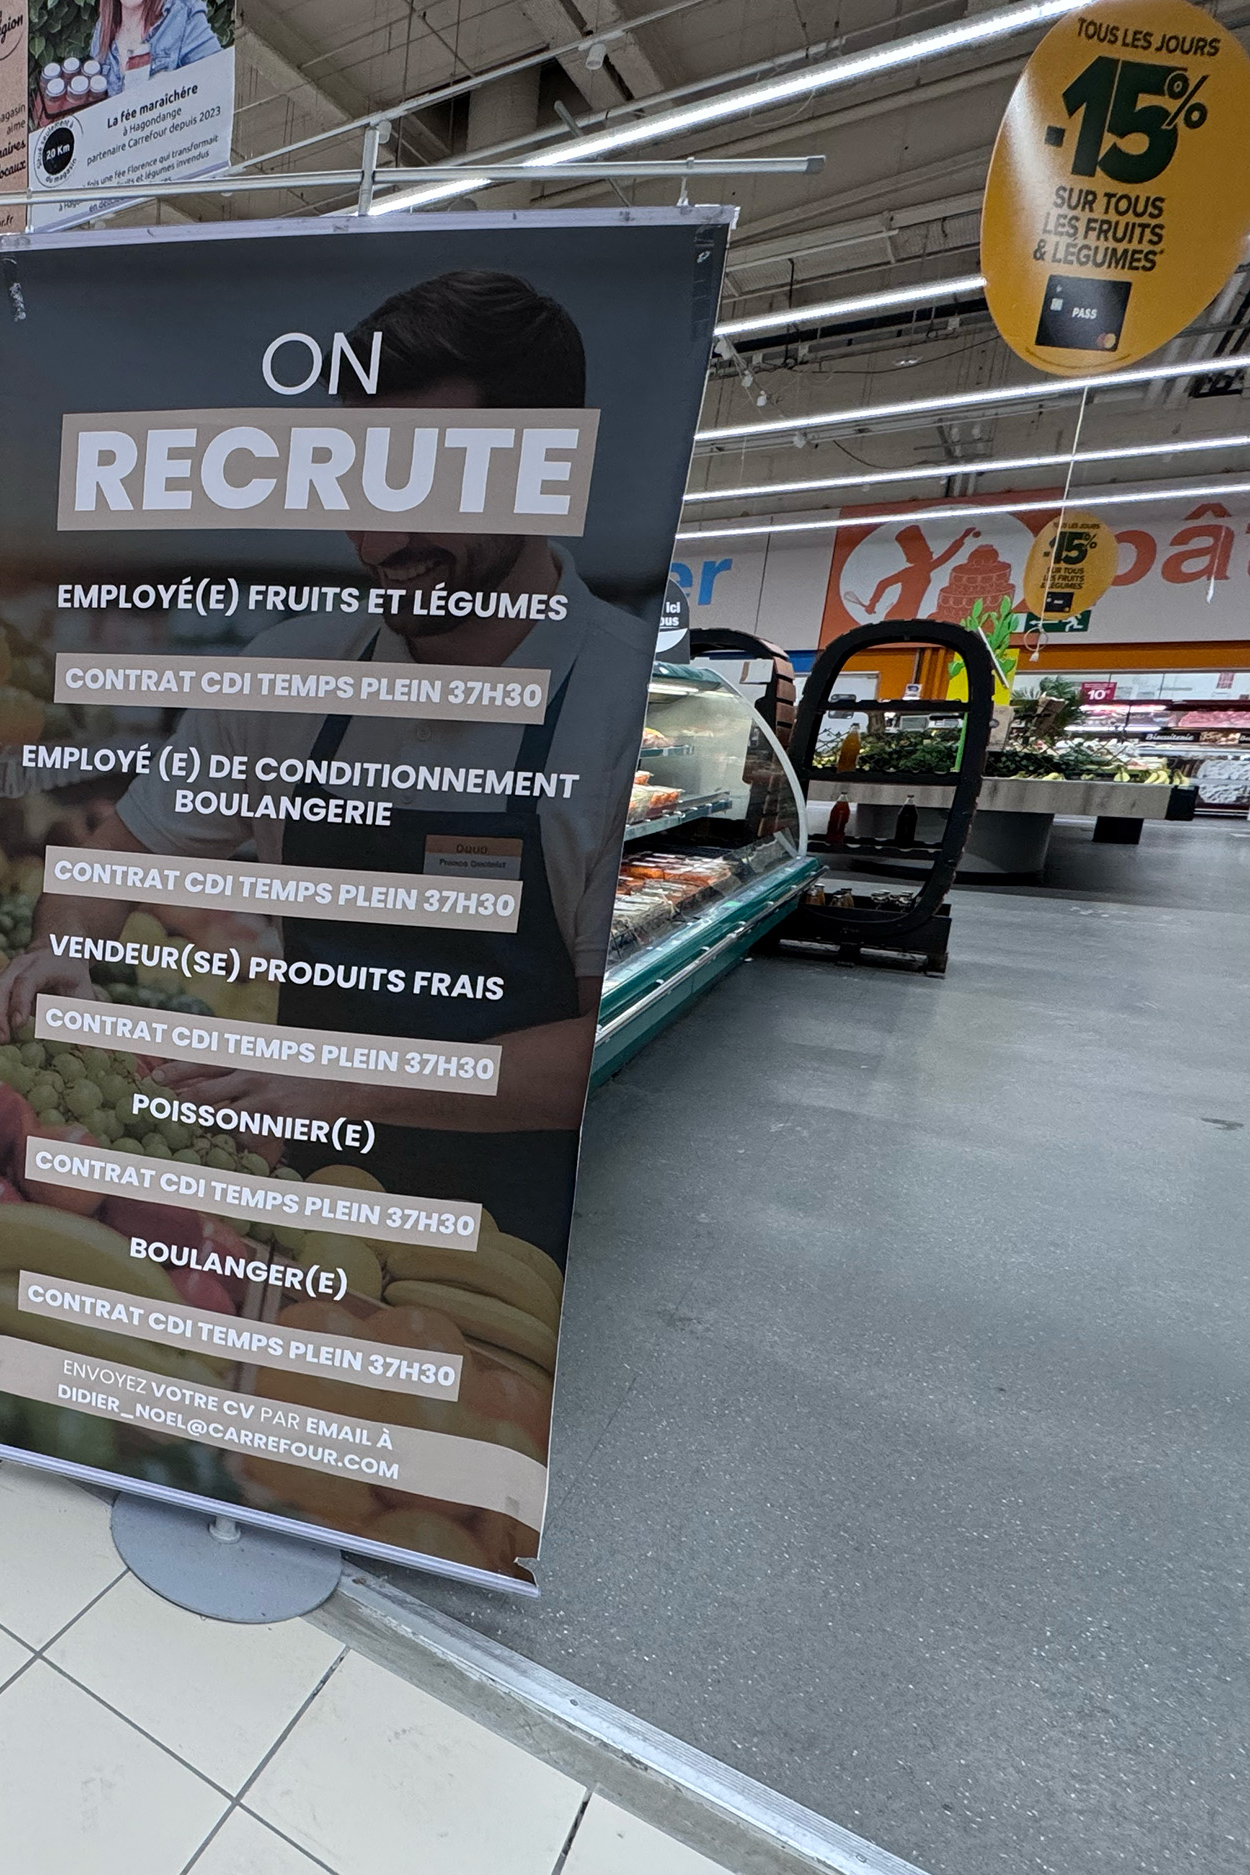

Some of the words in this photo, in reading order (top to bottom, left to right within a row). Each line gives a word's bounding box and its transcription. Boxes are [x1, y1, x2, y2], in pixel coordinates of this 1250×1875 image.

[1077, 17, 1118, 44] TOUS
[1121, 28, 1152, 51] LES
[1154, 34, 1221, 57] JOURS
[6, 120, 26, 136] aime
[87, 142, 126, 167] partenaire
[128, 127, 167, 149] Carrefour
[169, 115, 197, 134] depuis
[199, 106, 221, 123] 2023
[107, 117, 118, 129] La
[121, 108, 136, 123] fée
[130, 107, 182, 134] Hagondange
[1044, 55, 1210, 184] -15%
[46, 148, 56, 160] 20
[57, 143, 70, 156] Km
[100, 172, 113, 183] une
[114, 169, 126, 180] fée
[127, 159, 157, 175] Florence
[158, 153, 170, 164] qui
[171, 135, 219, 158] transformait
[136, 174, 144, 183] et
[144, 164, 175, 180] légumes
[176, 150, 210, 168] invendus
[1053, 185, 1097, 213] SUR
[1102, 192, 1166, 219] TOUS
[1033, 239, 1047, 261] &
[1042, 212, 1080, 238] LES
[1083, 219, 1165, 245] FRUITS
[1071, 307, 1098, 321] PASS
[262, 331, 383, 396] ON
[74, 425, 581, 515] RECRUTE
[1057, 574, 1085, 582] FRUITS
[1063, 567, 1085, 575] TOUS
[57, 576, 239, 617] EMPLOYÉ(E)
[248, 585, 360, 613] FRUITS
[367, 588, 407, 615] ET
[413, 582, 569, 621] LÉGUMES
[665, 601, 681, 614] ici
[659, 616, 680, 626] ous
[65, 667, 196, 693] CONTRAT
[201, 671, 251, 695] CDI
[257, 673, 354, 699] TEMPS
[360, 677, 442, 703] PLEIN
[447, 680, 542, 708] 37H30
[22, 743, 151, 774] EMPLOYÉ
[158, 745, 200, 783] (E)
[209, 754, 248, 780] DE
[255, 757, 580, 799] CONDITIONNEMENT
[174, 789, 393, 826] BOULANGERIE
[54, 860, 180, 891] CONTRAT
[184, 872, 233, 896] CDI
[239, 876, 333, 904] TEMPS
[338, 884, 418, 911] PLEIN
[423, 889, 515, 917] 37H30
[49, 934, 241, 983] VENDEUR(SE)
[248, 957, 406, 993] PRODUITS
[413, 971, 505, 1001] FRAIS
[45, 1008, 167, 1043] CONTRAT
[171, 1026, 219, 1051] CDI
[224, 1033, 316, 1064] TEMPS
[321, 1044, 399, 1072] PLEIN
[404, 1052, 494, 1081] 37H30
[132, 1093, 376, 1154] POISSONNIER(E)
[35, 1151, 156, 1188] CONTRAT
[159, 1173, 205, 1198] CDI
[211, 1181, 299, 1214] TEMPS
[304, 1196, 380, 1225] PLEIN
[385, 1207, 475, 1236] 37H30
[129, 1237, 348, 1301] BOULANGER(E)
[27, 1284, 144, 1326] CONTRAT
[148, 1312, 192, 1338] CDI
[197, 1321, 284, 1356] TEMPS
[288, 1340, 363, 1372] PLEIN
[367, 1354, 456, 1387] 37H30
[63, 1359, 148, 1395] ENVOYEZ
[150, 1381, 219, 1412] VOTRE
[223, 1400, 255, 1419] CV
[260, 1407, 300, 1430] PAR
[305, 1417, 372, 1446] EMAIL
[376, 1427, 393, 1451] À
[57, 1383, 399, 1480] DIDIER_NOEL@CARREFOUR.COM
